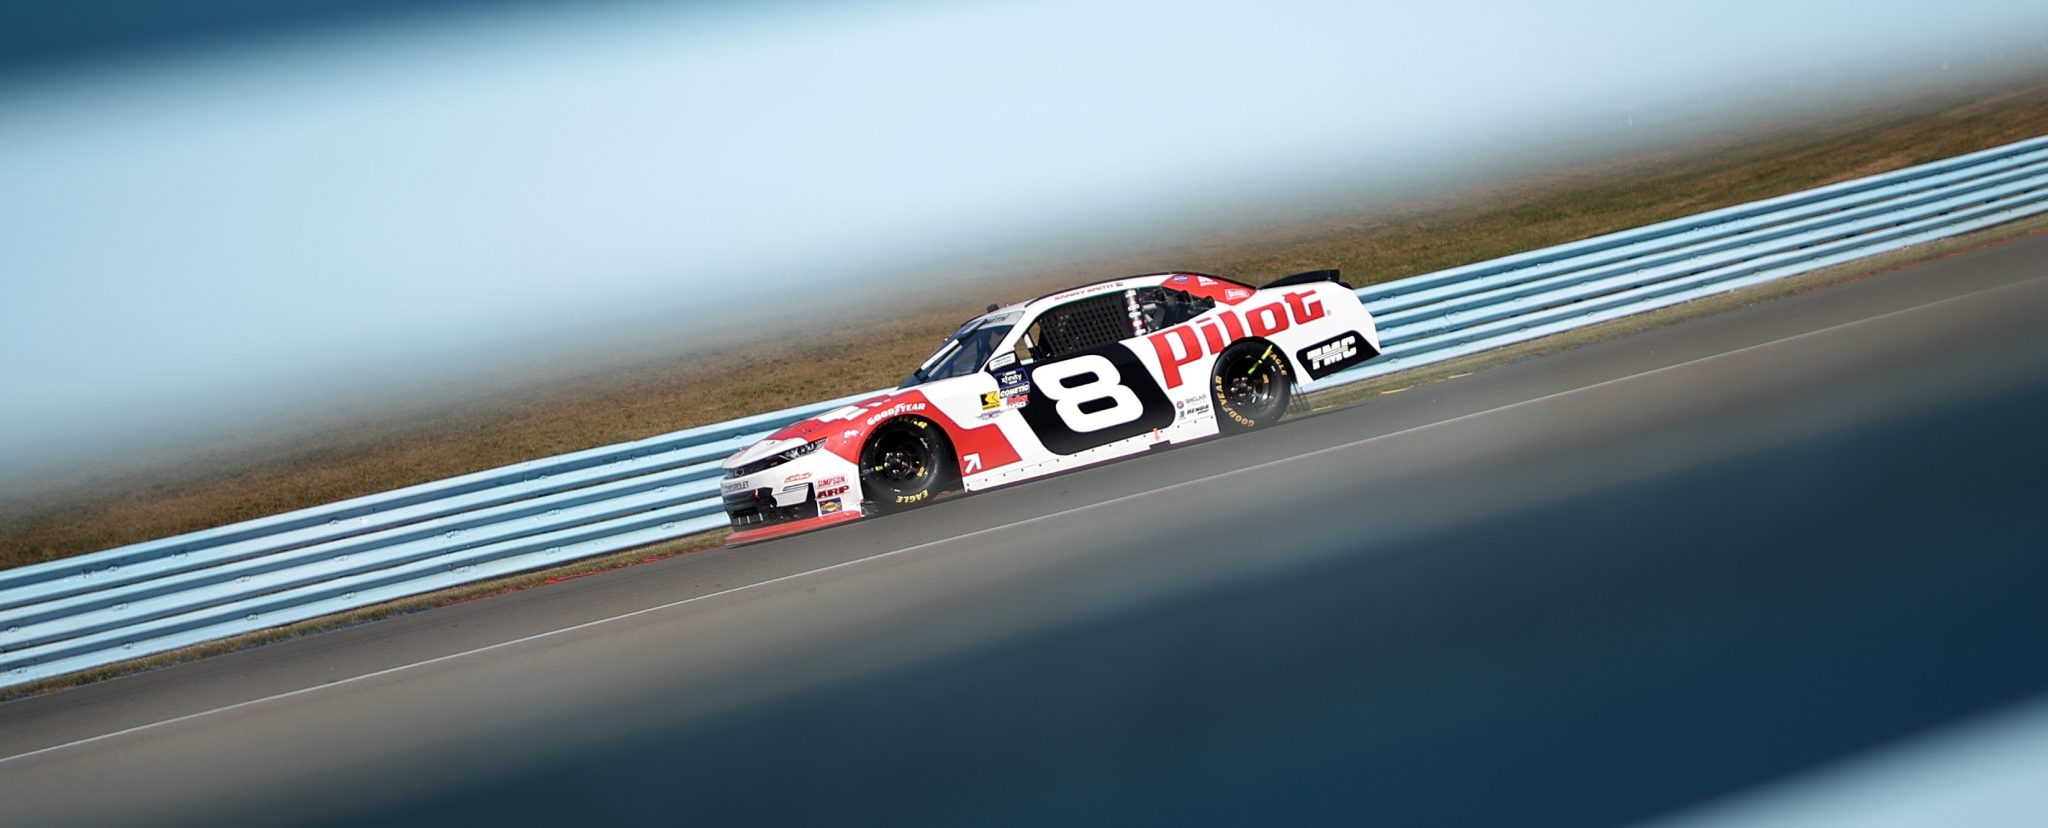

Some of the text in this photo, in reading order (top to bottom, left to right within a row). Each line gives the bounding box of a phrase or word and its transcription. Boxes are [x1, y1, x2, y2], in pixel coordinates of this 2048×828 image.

[1306, 335, 1357, 370] TMC
[1000, 384, 1029, 398] COMETIC
[1031, 354, 1144, 433] 8
[1214, 375, 1255, 427] GOODYEAR
[866, 402, 926, 426] GOODYEAR
[817, 475, 846, 489] SIMPSON
[817, 485, 849, 499] ARP
[895, 489, 928, 504] EAGLE
